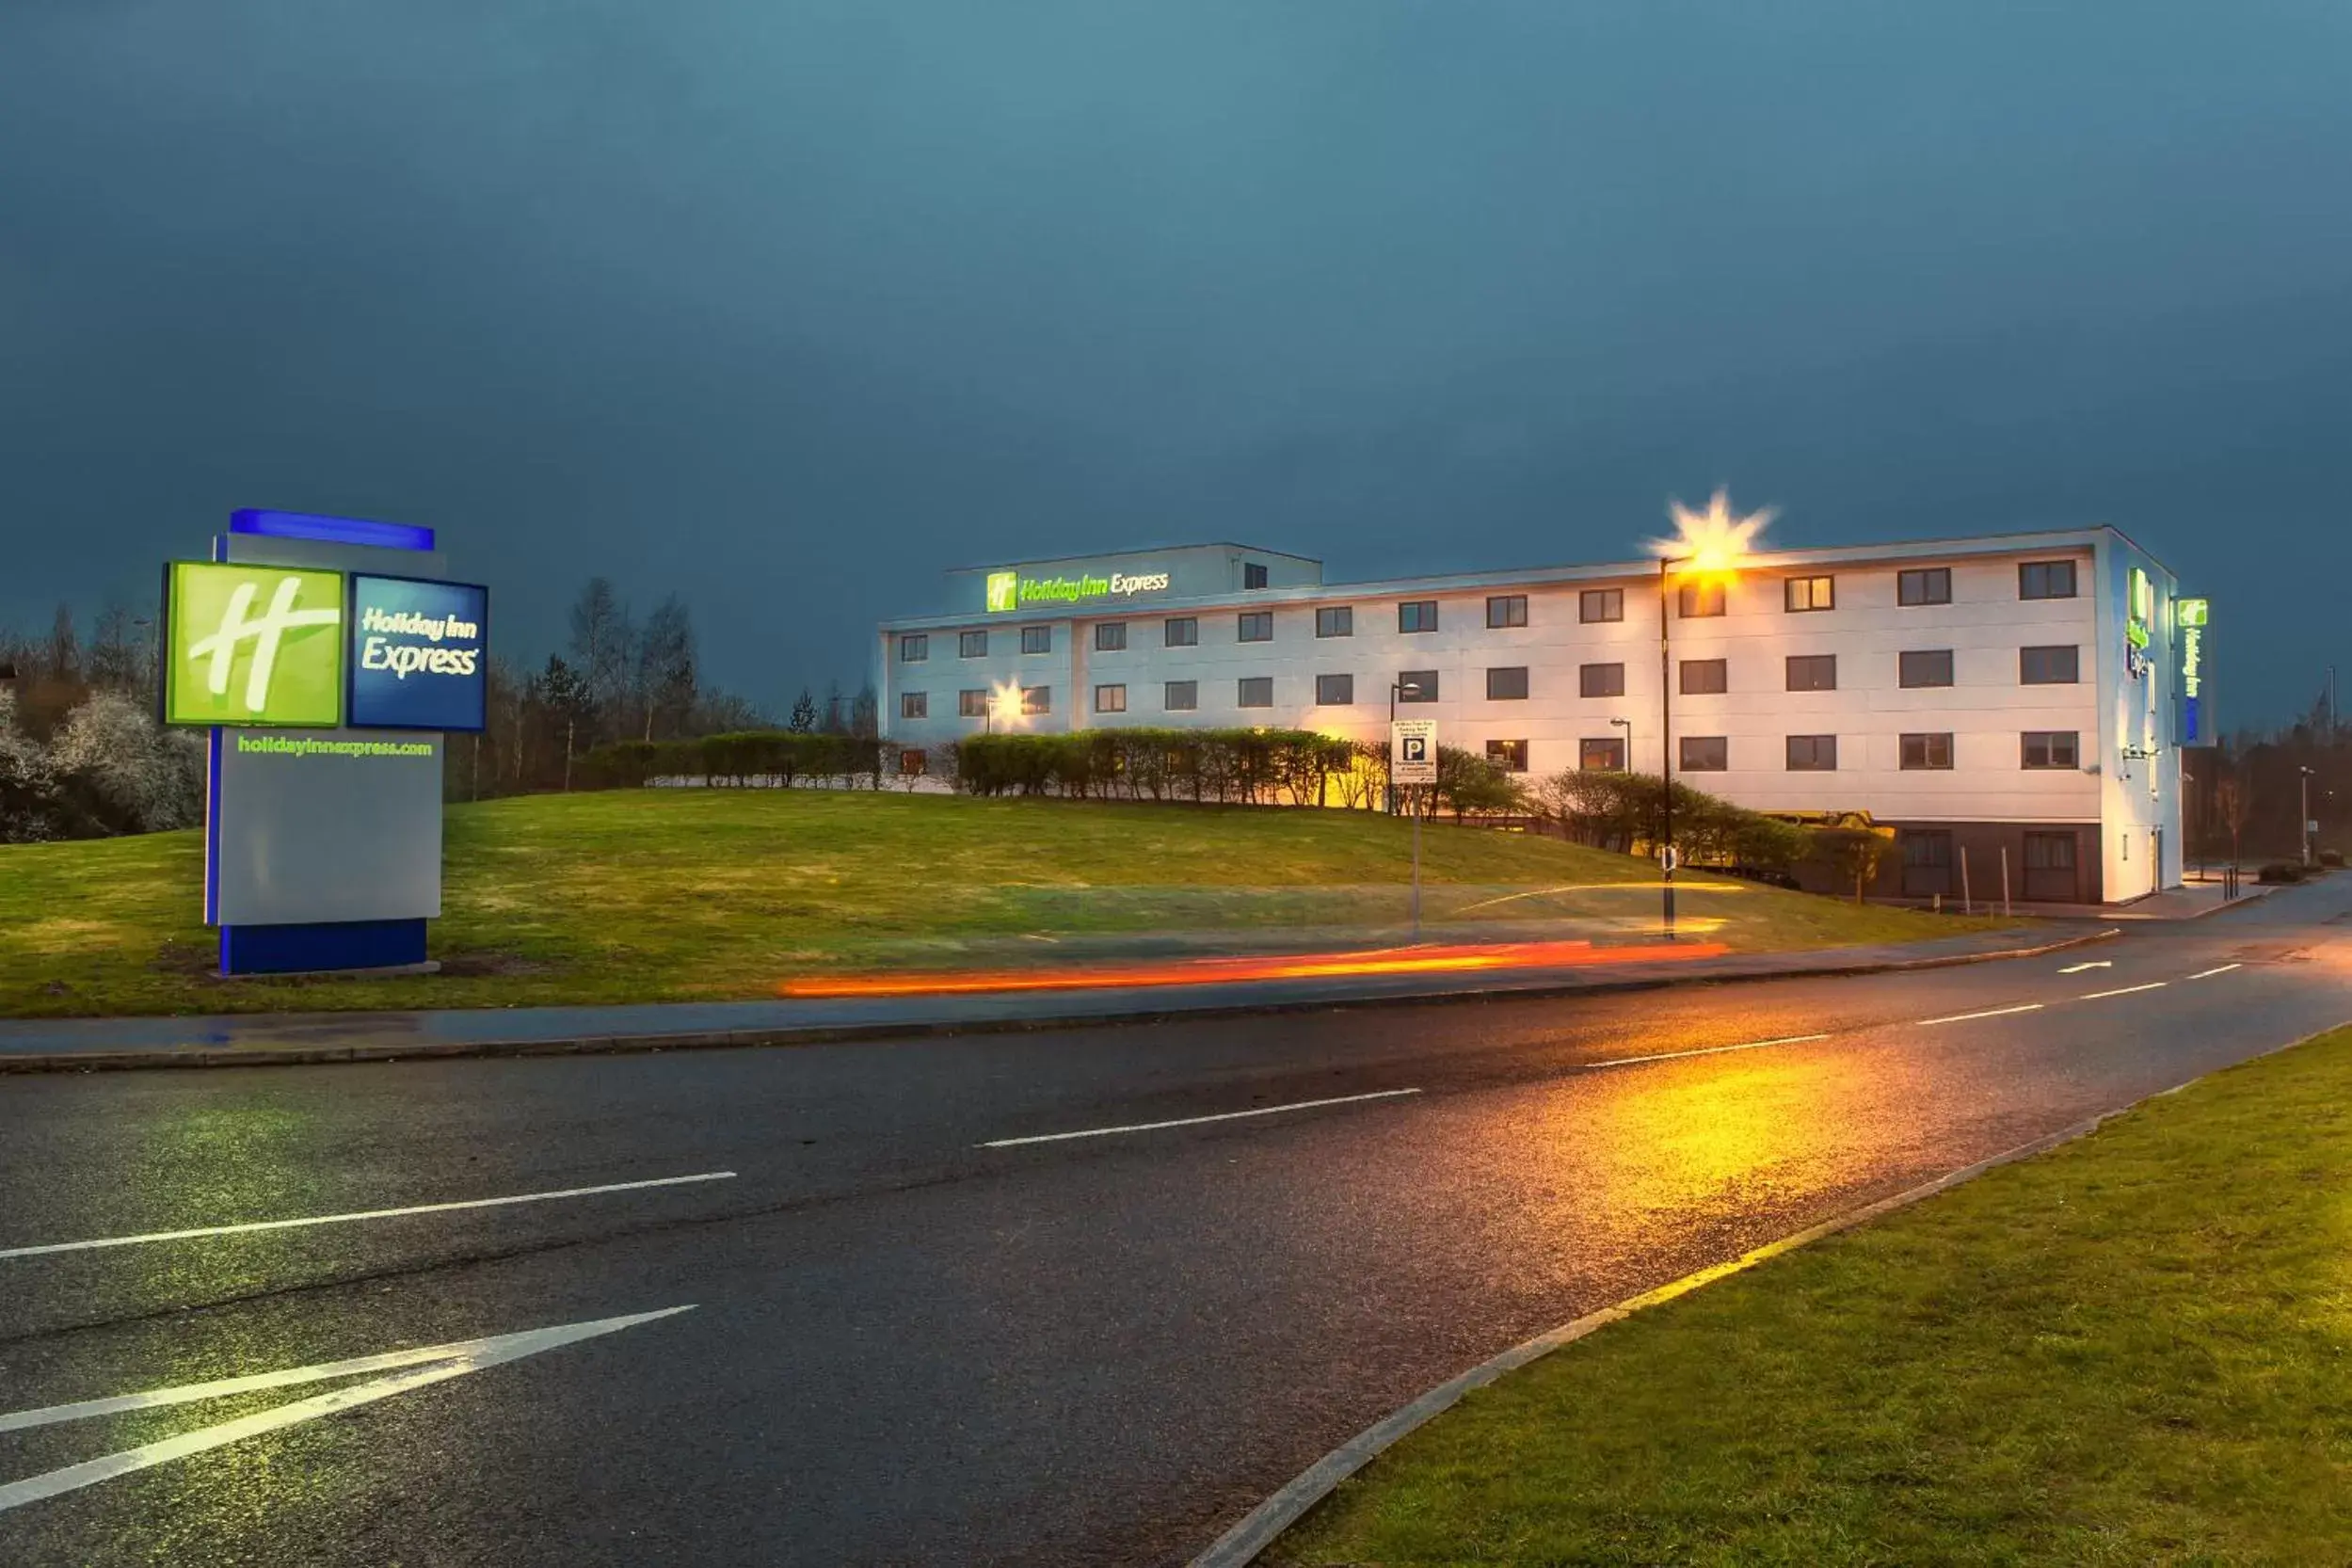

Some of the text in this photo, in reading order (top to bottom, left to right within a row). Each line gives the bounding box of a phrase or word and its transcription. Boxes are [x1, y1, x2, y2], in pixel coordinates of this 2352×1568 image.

[1020, 577, 1080, 602] Holiday
[1081, 574, 1109, 597] Inn
[1111, 572, 1170, 596] Express
[362, 607, 477, 642] Holiday Inn
[188, 576, 340, 712] H
[362, 636, 479, 680] Express
[2183, 628, 2201, 676] Holiday
[2185, 676, 2201, 697] Inn
[238, 735, 432, 758] holidayinnexpress.com
[1407, 740, 1422, 760] P
